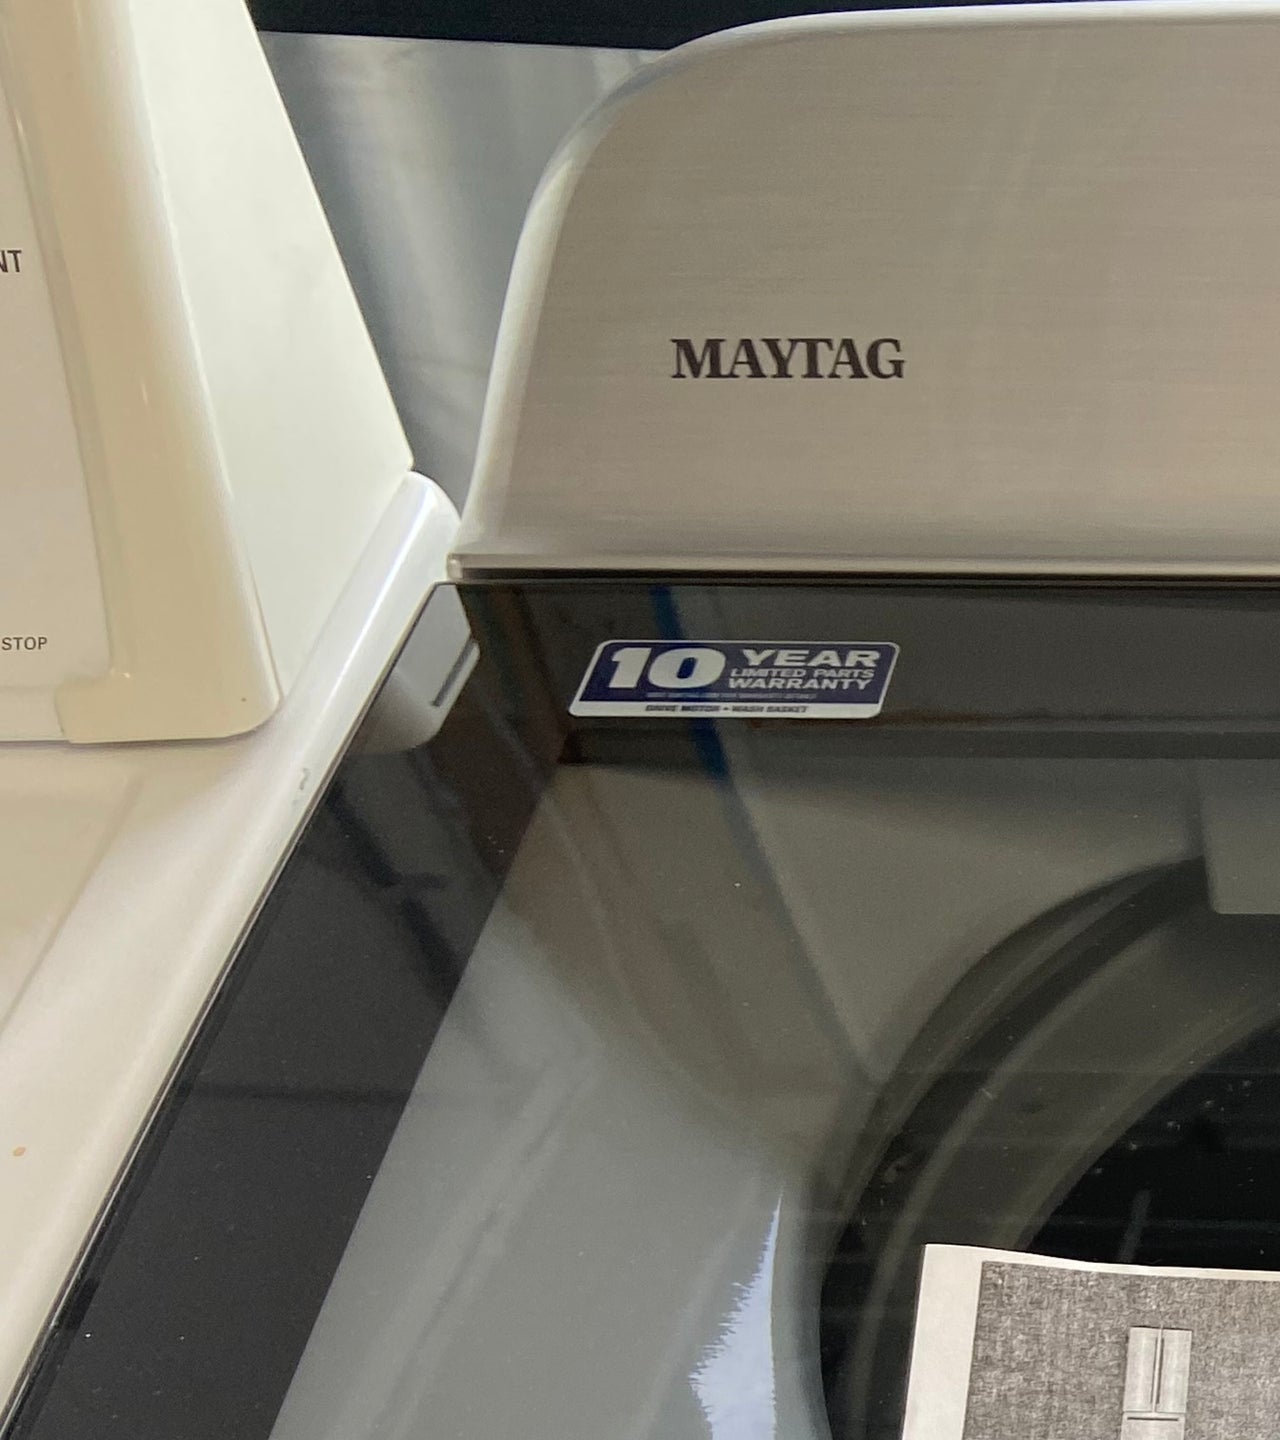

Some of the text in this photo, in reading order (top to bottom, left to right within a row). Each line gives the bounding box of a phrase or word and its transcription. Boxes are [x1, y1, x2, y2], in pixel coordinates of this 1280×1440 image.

[669, 337, 906, 380] MAYTAG
[1, 636, 48, 651] STOP
[608, 647, 881, 690] 10 YEAR
[730, 668, 875, 679] LIMITED PARTS
[728, 678, 873, 691] WARRANTY
